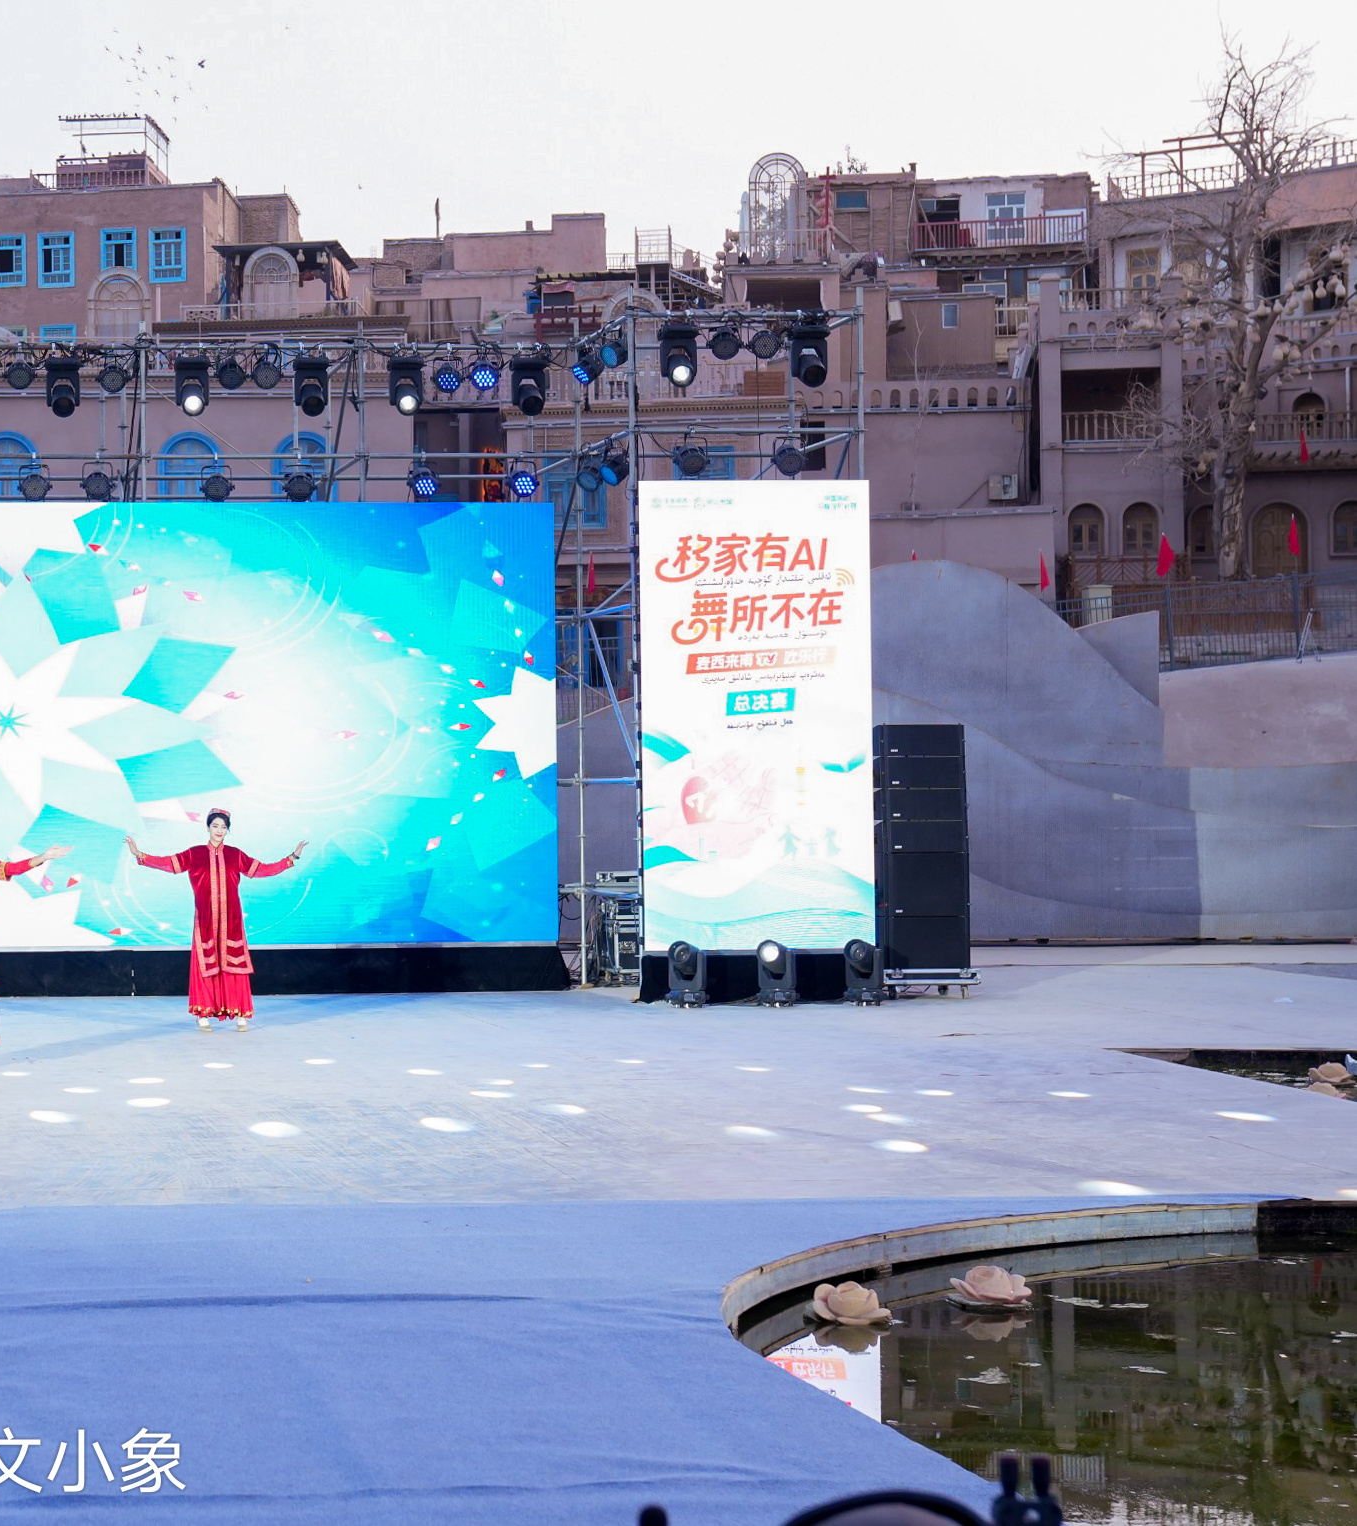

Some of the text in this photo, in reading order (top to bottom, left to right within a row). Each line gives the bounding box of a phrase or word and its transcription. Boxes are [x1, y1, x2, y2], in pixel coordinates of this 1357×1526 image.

[655, 532, 828, 583] 移家有AI
[671, 588, 844, 646] 舞所不在
[733, 691, 789, 711] 总决赛
